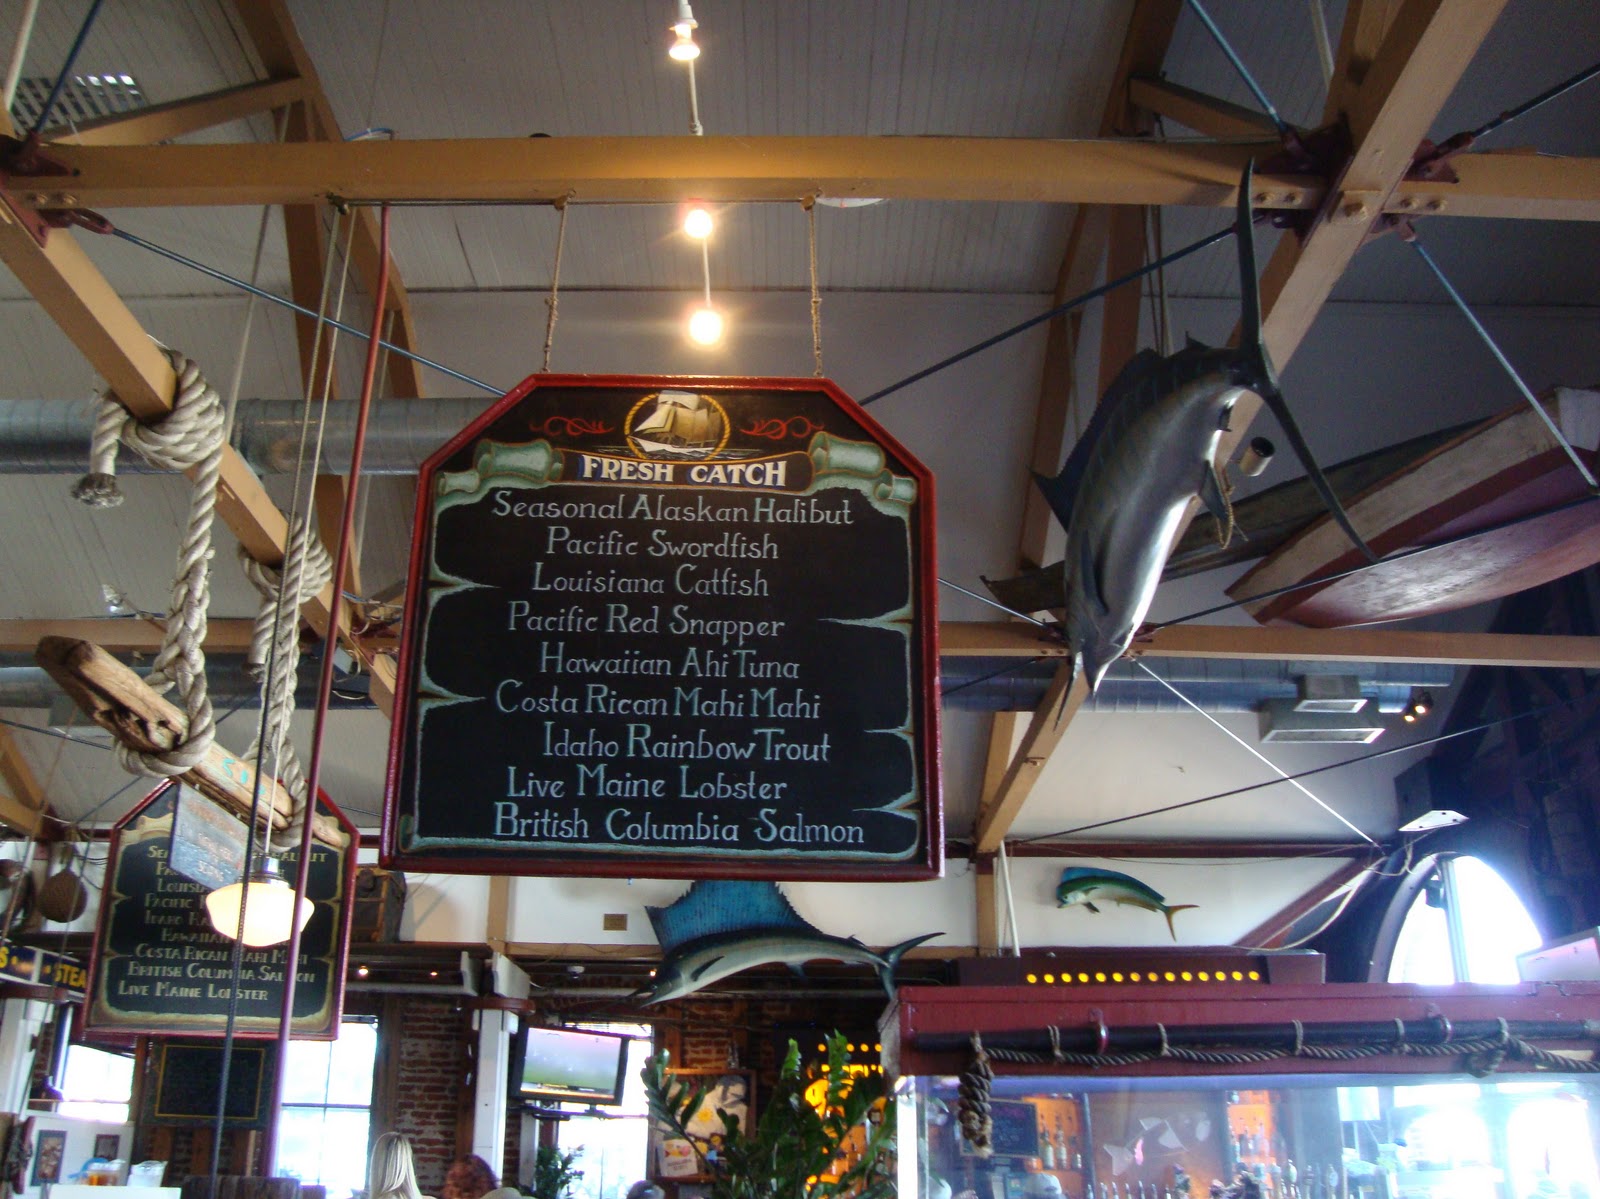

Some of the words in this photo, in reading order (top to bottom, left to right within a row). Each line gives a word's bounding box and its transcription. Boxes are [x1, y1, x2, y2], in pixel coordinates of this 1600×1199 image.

[581, 454, 675, 483] FRESH
[689, 459, 787, 487] CATCH
[493, 490, 624, 519] Seasonal
[627, 493, 749, 523] Alaskan
[753, 497, 854, 525] Halibut
[546, 525, 639, 556] Pacific
[647, 529, 779, 559] Swordfish
[532, 562, 665, 594] Louisiana
[675, 564, 769, 597] Catfish
[509, 600, 598, 633] Pacific
[606, 603, 659, 634] Red
[669, 604, 785, 647] Snapper
[541, 641, 672, 676] Hawaiian
[680, 647, 729, 678] Ahi
[733, 649, 800, 679] Tuna
[496, 679, 579, 714] Costa
[586, 683, 668, 716] Rican
[673, 686, 744, 718] Mahi
[750, 687, 821, 719] Mahi
[543, 721, 619, 757] Idaho
[627, 723, 756, 760] Rainbow
[754, 728, 831, 762] Trout
[507, 766, 565, 798] Live
[577, 764, 665, 798] Maine
[680, 766, 788, 800] Lobster
[494, 802, 589, 838] British
[605, 808, 739, 842] Columbia
[754, 809, 865, 843] Salmon
[187, 963, 255, 980] COLUMIA
[258, 965, 316, 983] SALON
